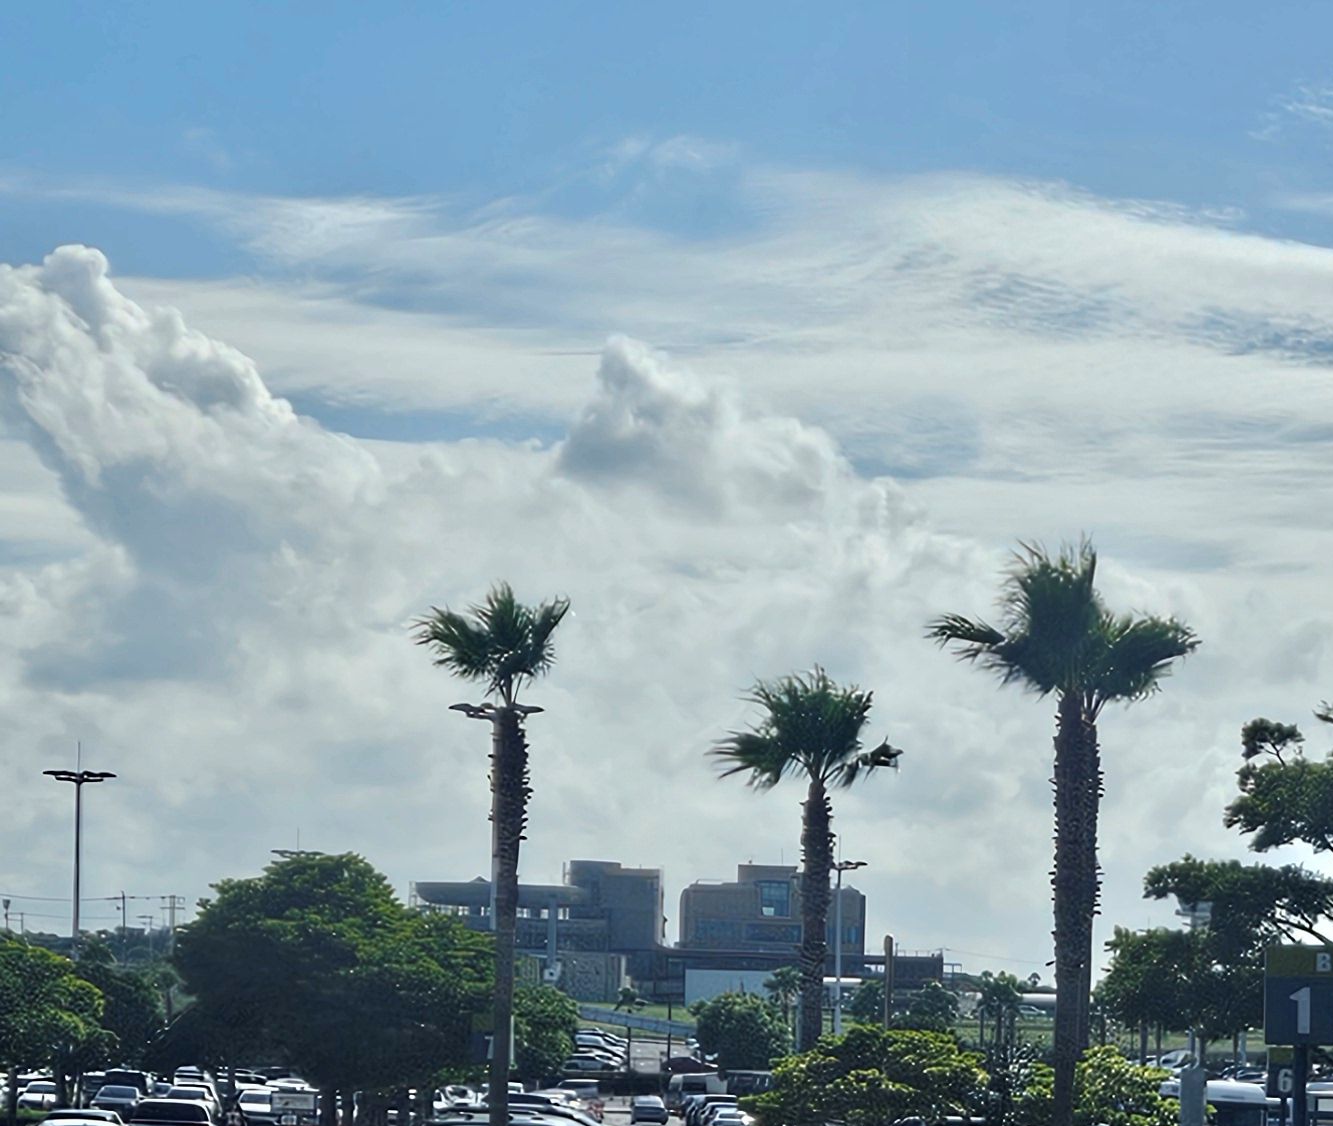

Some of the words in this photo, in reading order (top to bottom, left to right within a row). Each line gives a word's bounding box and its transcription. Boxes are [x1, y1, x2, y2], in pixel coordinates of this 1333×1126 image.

[1315, 951, 1332, 973] B
[1289, 986, 1311, 1035] 1
[1277, 1068, 1293, 1093] 6
